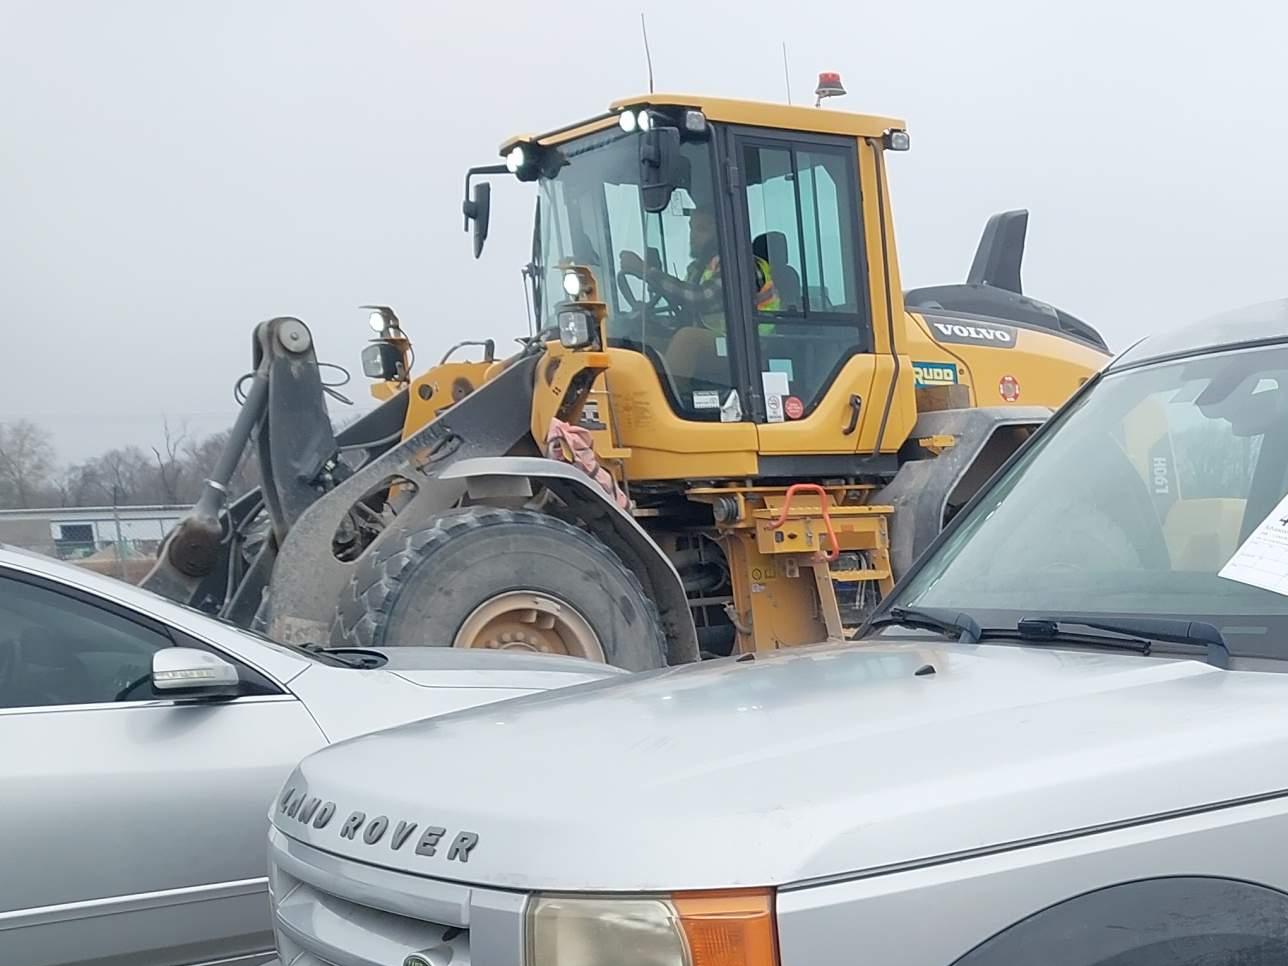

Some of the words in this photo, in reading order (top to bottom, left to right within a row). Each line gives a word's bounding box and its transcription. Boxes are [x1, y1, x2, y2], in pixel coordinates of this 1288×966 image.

[934, 323, 1010, 342] VOLVO
[912, 367, 954, 384] RUDD
[1153, 457, 1168, 494] L90H
[280, 788, 336, 829] LAND
[340, 811, 479, 863] ROVER
